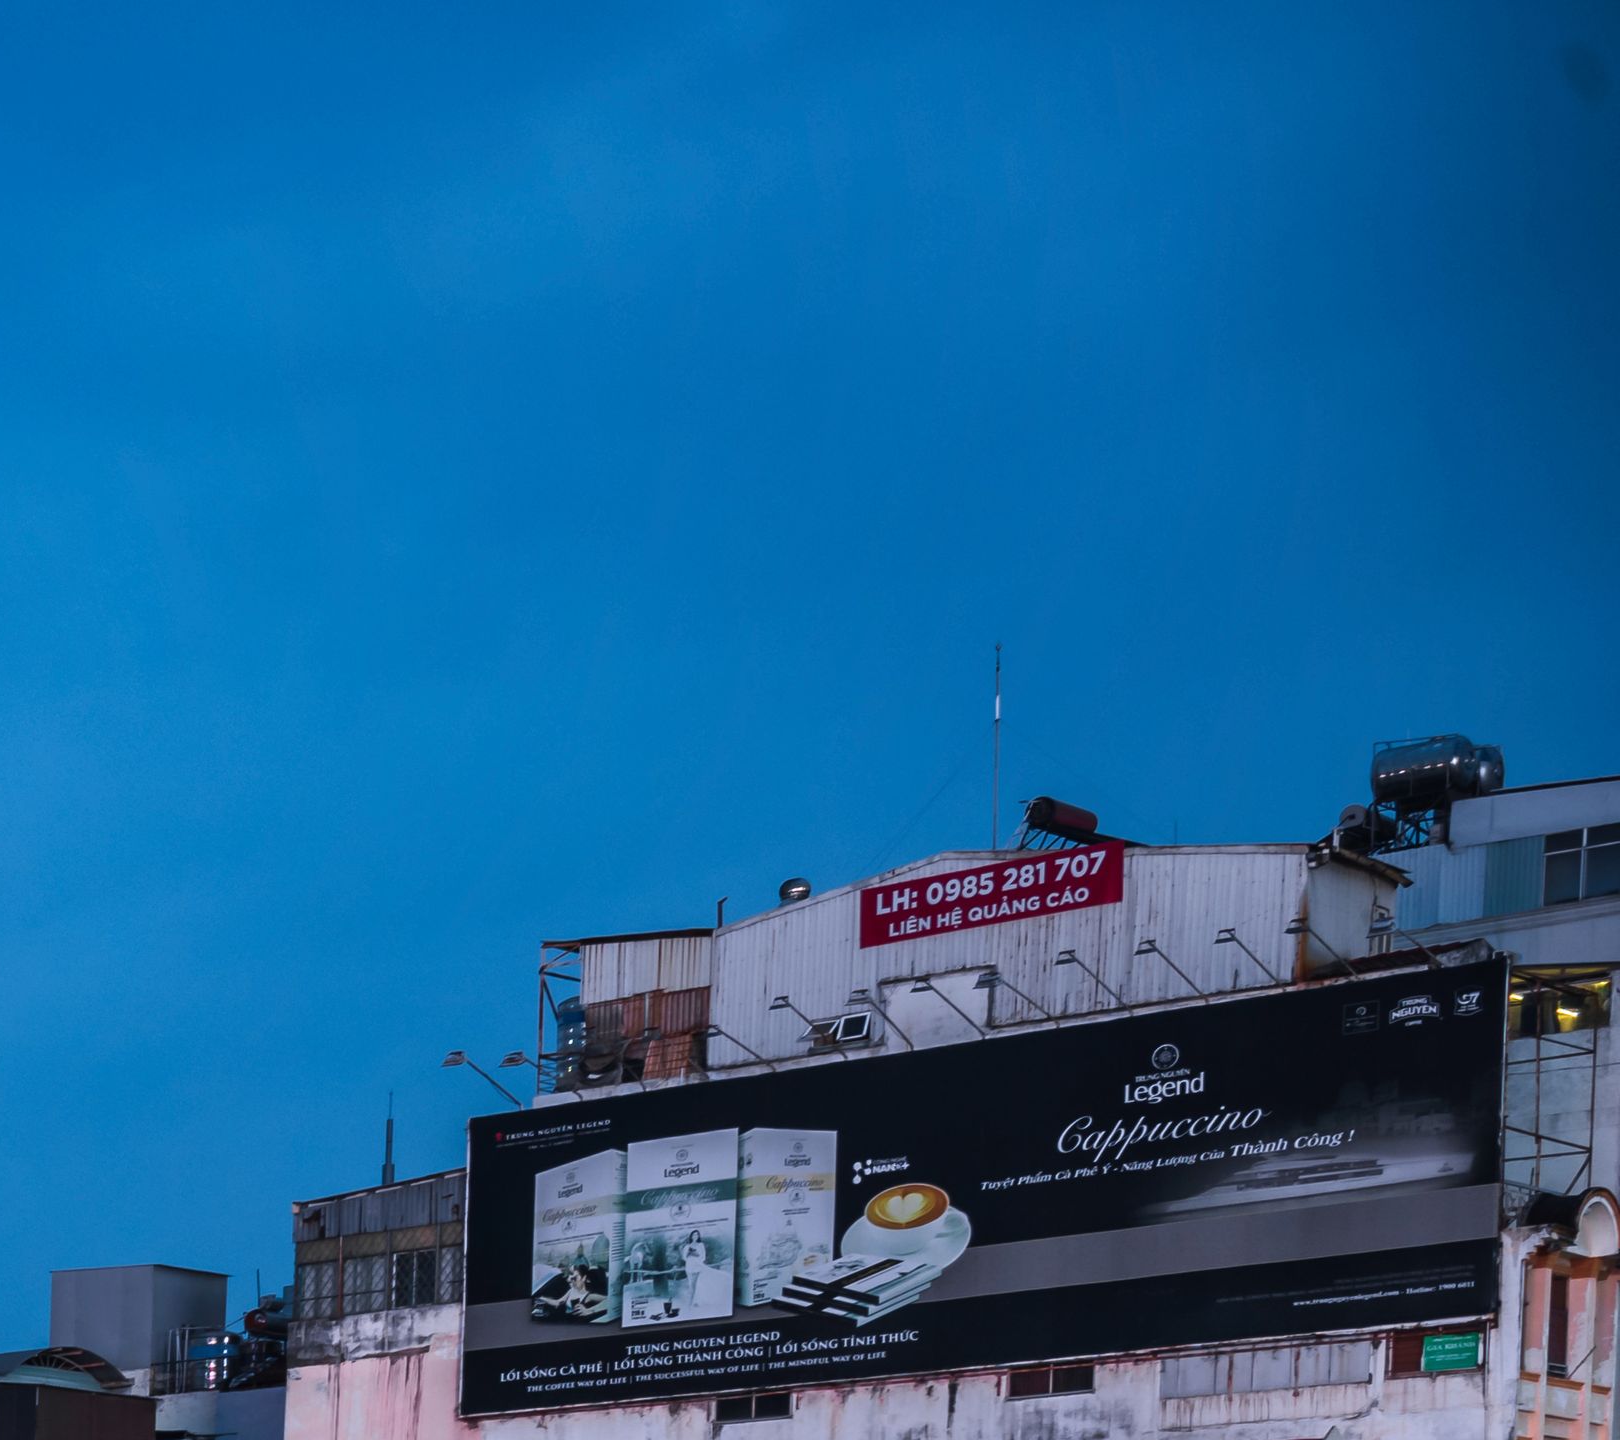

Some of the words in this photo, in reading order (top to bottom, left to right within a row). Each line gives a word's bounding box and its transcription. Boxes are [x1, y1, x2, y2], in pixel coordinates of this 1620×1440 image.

[876, 887, 918, 916] LH:
[925, 871, 995, 907] 0985
[1001, 861, 1046, 891] 281
[1054, 850, 1107, 883] 707
[888, 915, 932, 938] LIÊN
[936, 908, 963, 930] HỆ
[967, 896, 1041, 922] QUẢNG
[1046, 885, 1090, 908] CÁO
[1123, 1072, 1205, 1106] Legend
[1056, 1104, 1271, 1163] Cappuccino
[663, 1163, 700, 1179] Legend
[500, 1367, 520, 1383] LỐI
[522, 1364, 558, 1381] SỐNG
[561, 1362, 577, 1378] CÀ
[579, 1358, 604, 1376] PHÊ
[614, 1355, 636, 1372] LỐI
[638, 1352, 673, 1369] SỐNG
[675, 1347, 720, 1366] THÀNH
[723, 1343, 765, 1361] CÔNG
[775, 1338, 796, 1356] LỐI
[798, 1335, 836, 1354] SỐNG
[838, 1332, 876, 1351] TỈNH
[878, 1328, 920, 1347] THỨC
[625, 1340, 670, 1356] TRUNG
[673, 1336, 726, 1353] NGUYEN
[727, 1330, 781, 1347] LEGEND
